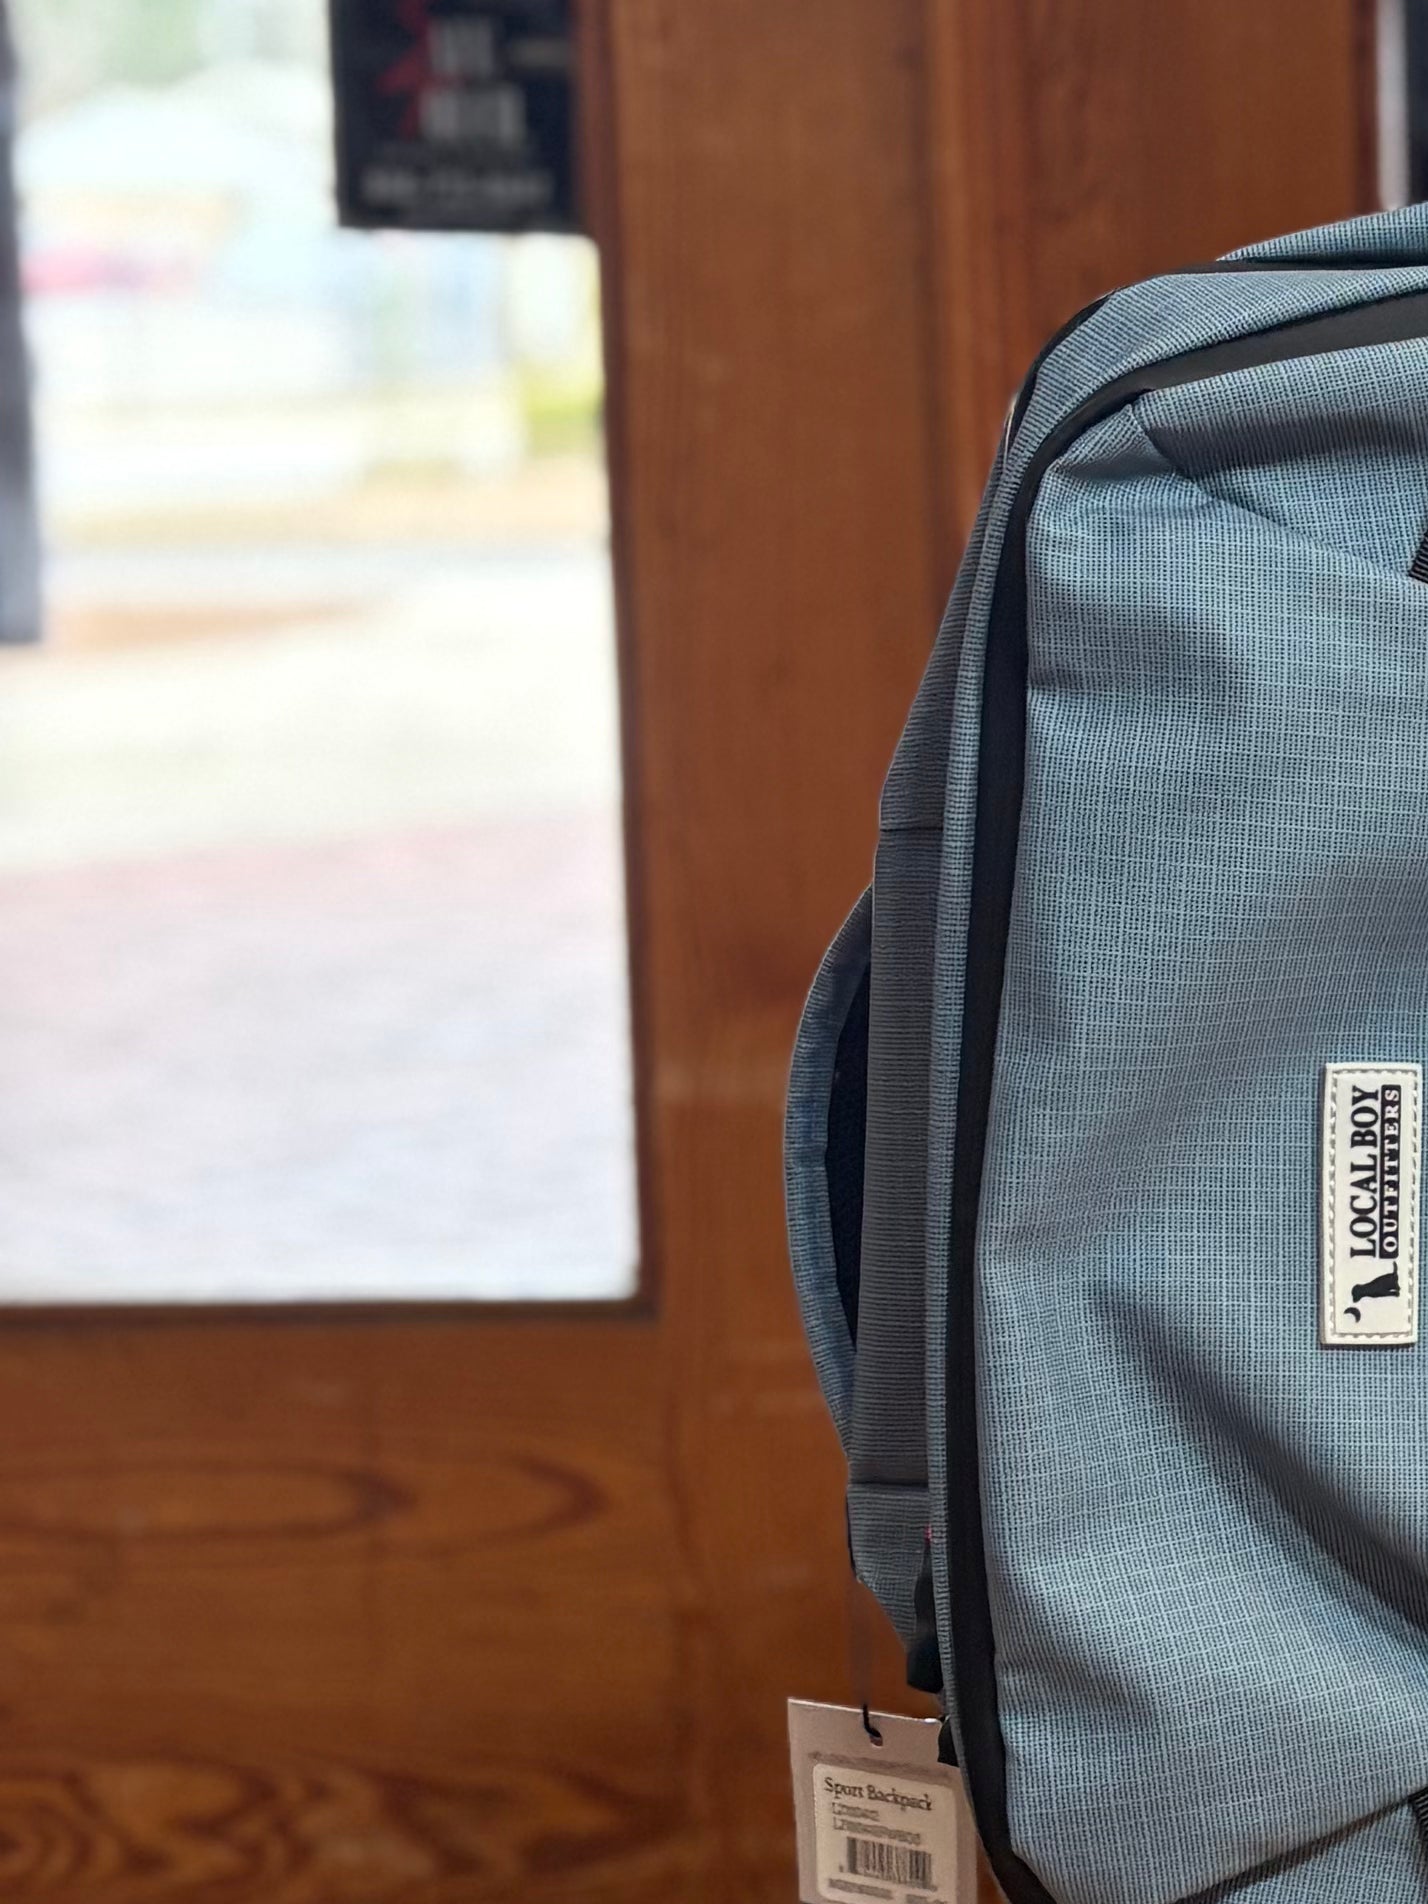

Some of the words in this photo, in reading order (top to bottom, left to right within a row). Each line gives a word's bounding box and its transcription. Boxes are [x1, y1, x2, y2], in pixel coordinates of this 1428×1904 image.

[1350, 1085, 1379, 1148] BOY
[1350, 1154, 1378, 1258] LOCAL
[1383, 1089, 1400, 1252] OUTFITTERS
[824, 1776, 863, 1800] Sport
[867, 1784, 932, 1812] Backpack
